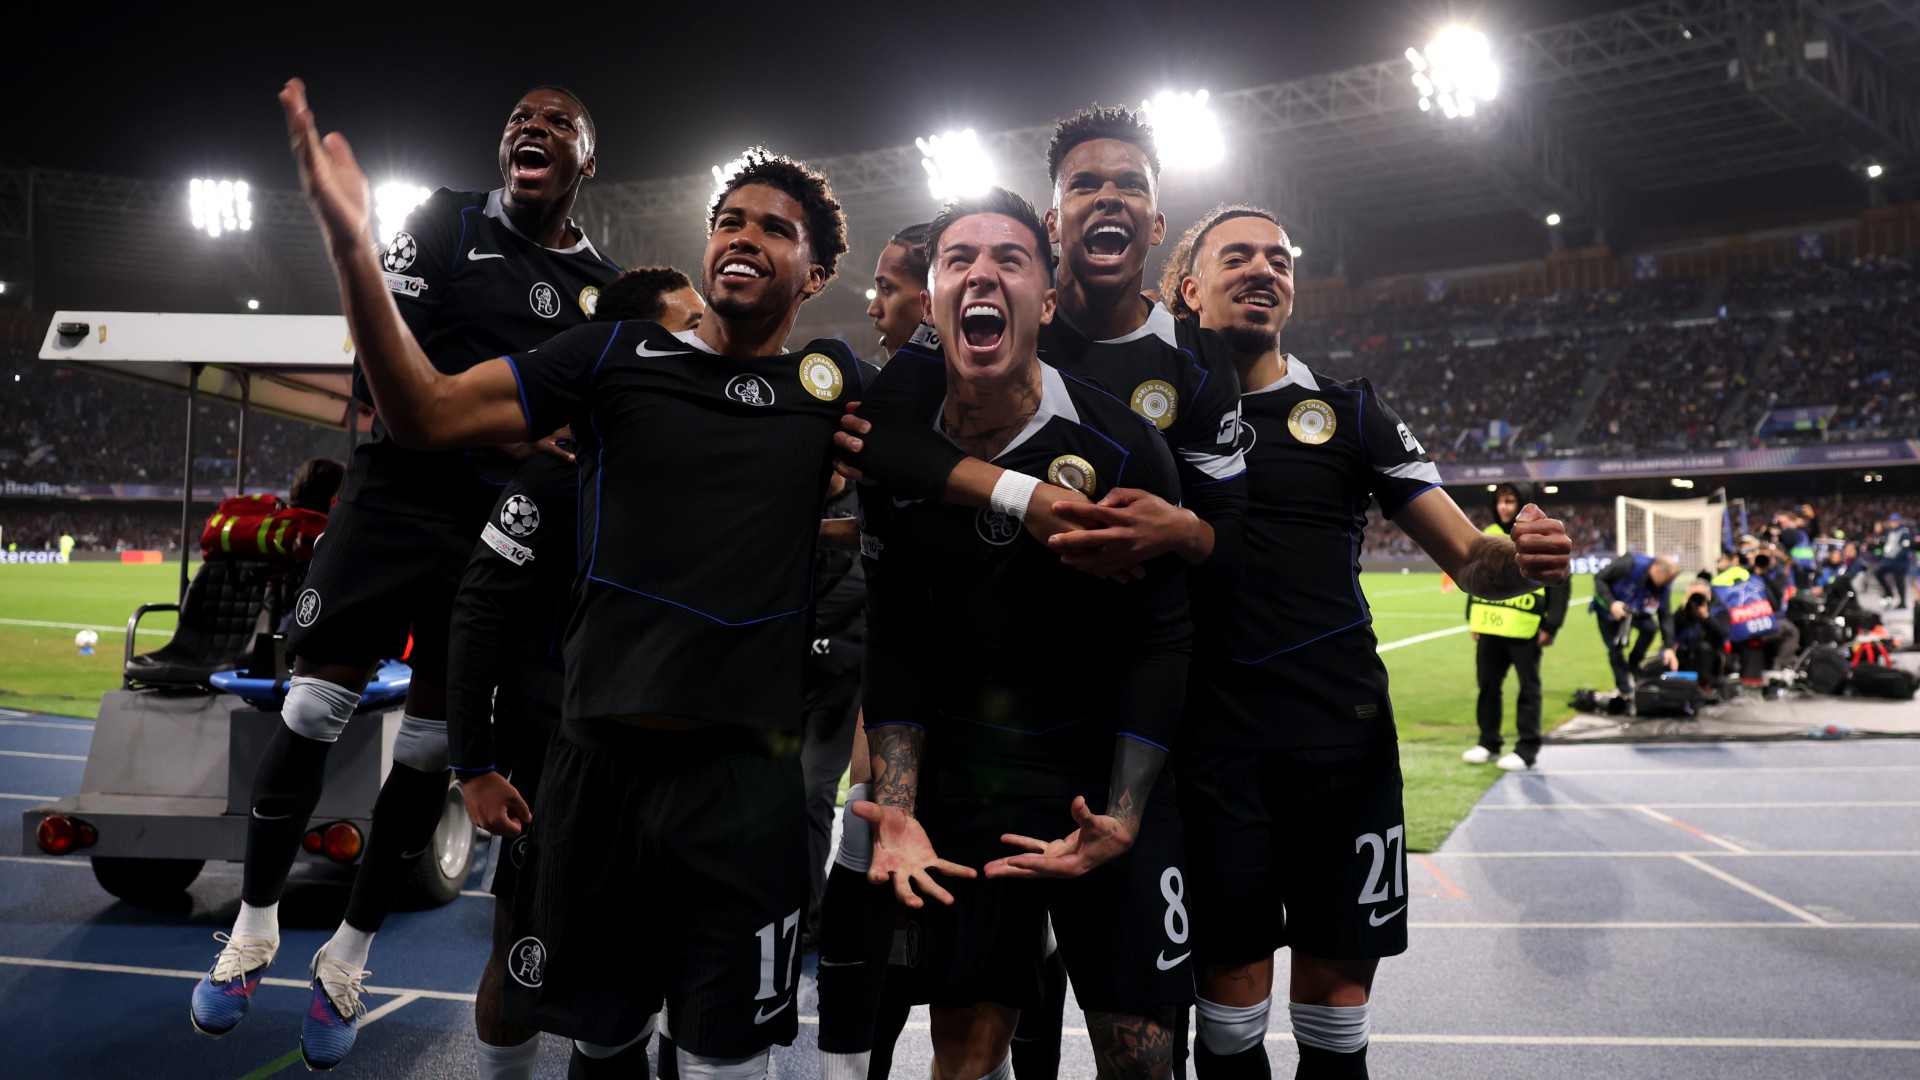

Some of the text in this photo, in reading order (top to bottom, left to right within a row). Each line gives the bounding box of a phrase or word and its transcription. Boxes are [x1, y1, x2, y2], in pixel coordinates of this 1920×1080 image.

[803, 357, 840, 385] WORLD CHAMPIONS
[815, 388, 833, 398] FIFA
[1135, 384, 1176, 418] WORLD CHAMPIONS
[1292, 402, 1333, 430] WORLD CHAMPIONS
[1301, 433, 1320, 441] FIFA
[1355, 824, 1405, 905] 27
[1160, 866, 1189, 944] 8
[754, 907, 801, 1001] 17
